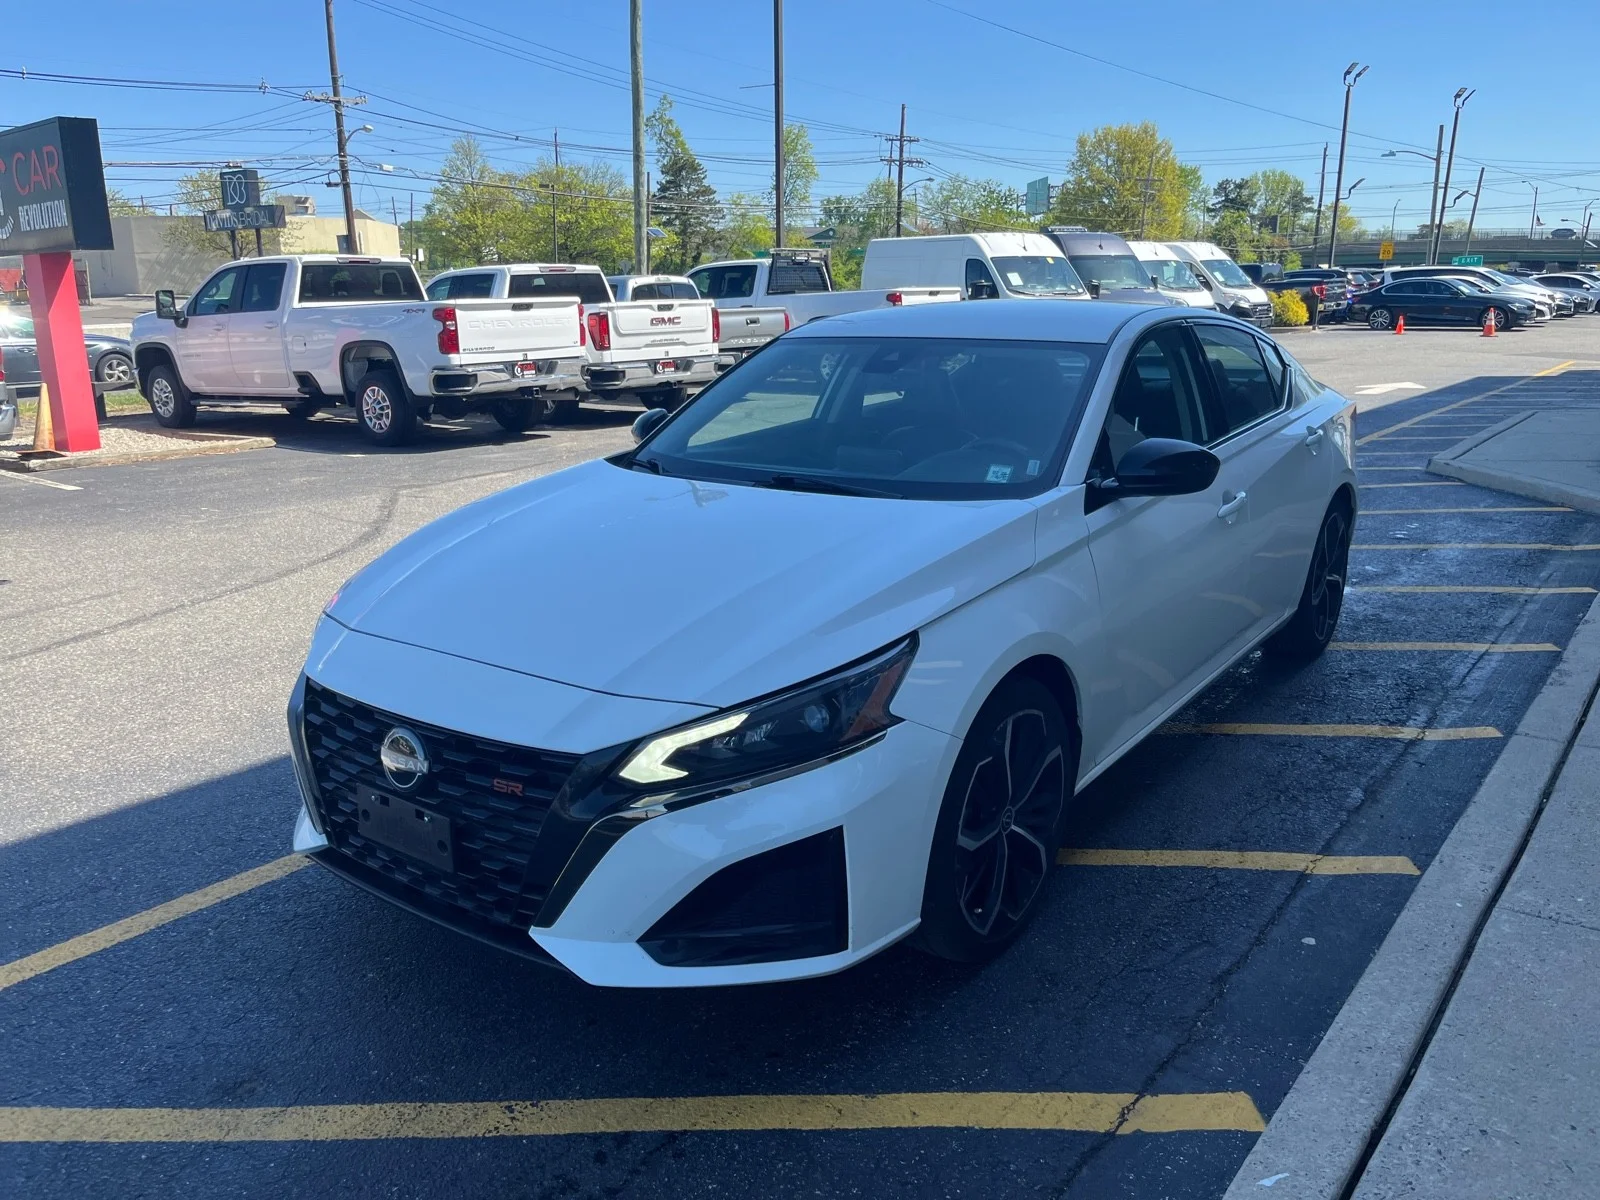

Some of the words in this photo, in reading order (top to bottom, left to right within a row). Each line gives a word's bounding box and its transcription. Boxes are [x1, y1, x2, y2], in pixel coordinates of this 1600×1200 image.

[12, 145, 62, 196] CAR
[18, 199, 68, 232] REVOLUTION
[238, 209, 273, 227] BRIDAL
[466, 316, 573, 330] CHEVROLET
[650, 316, 682, 327] GMC
[384, 751, 428, 773] ISSAN
[493, 778, 524, 797] SR
